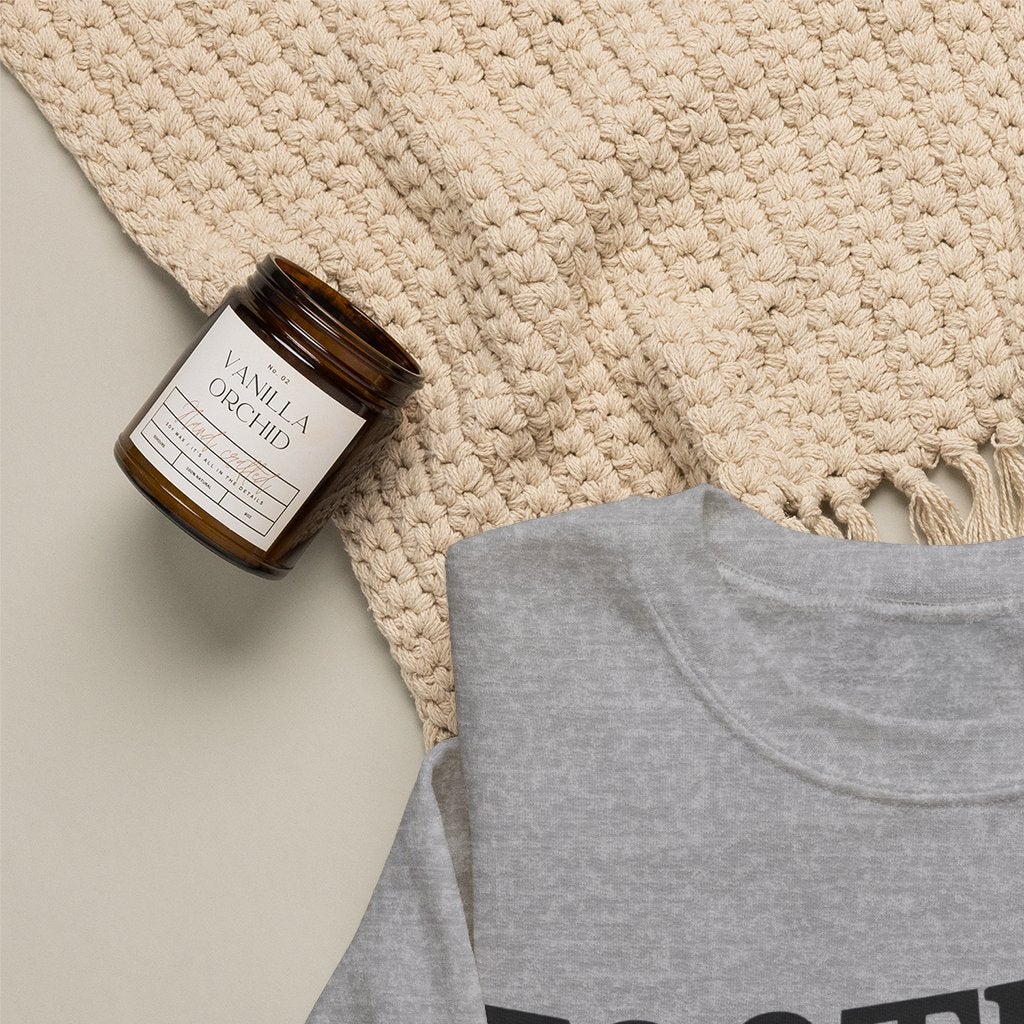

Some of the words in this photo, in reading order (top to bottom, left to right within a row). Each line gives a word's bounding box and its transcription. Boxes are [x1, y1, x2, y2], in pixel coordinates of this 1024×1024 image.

[224, 349, 309, 434] VANILLA
[267, 364, 278, 377] No.
[280, 375, 291, 385] 02
[208, 377, 291, 450] ORCHID
[175, 432, 186, 442] WAX
[191, 446, 202, 458] IT'S
[203, 458, 214, 469] ALL
[225, 475, 237, 486] THE
[238, 485, 264, 506] DETAILS
